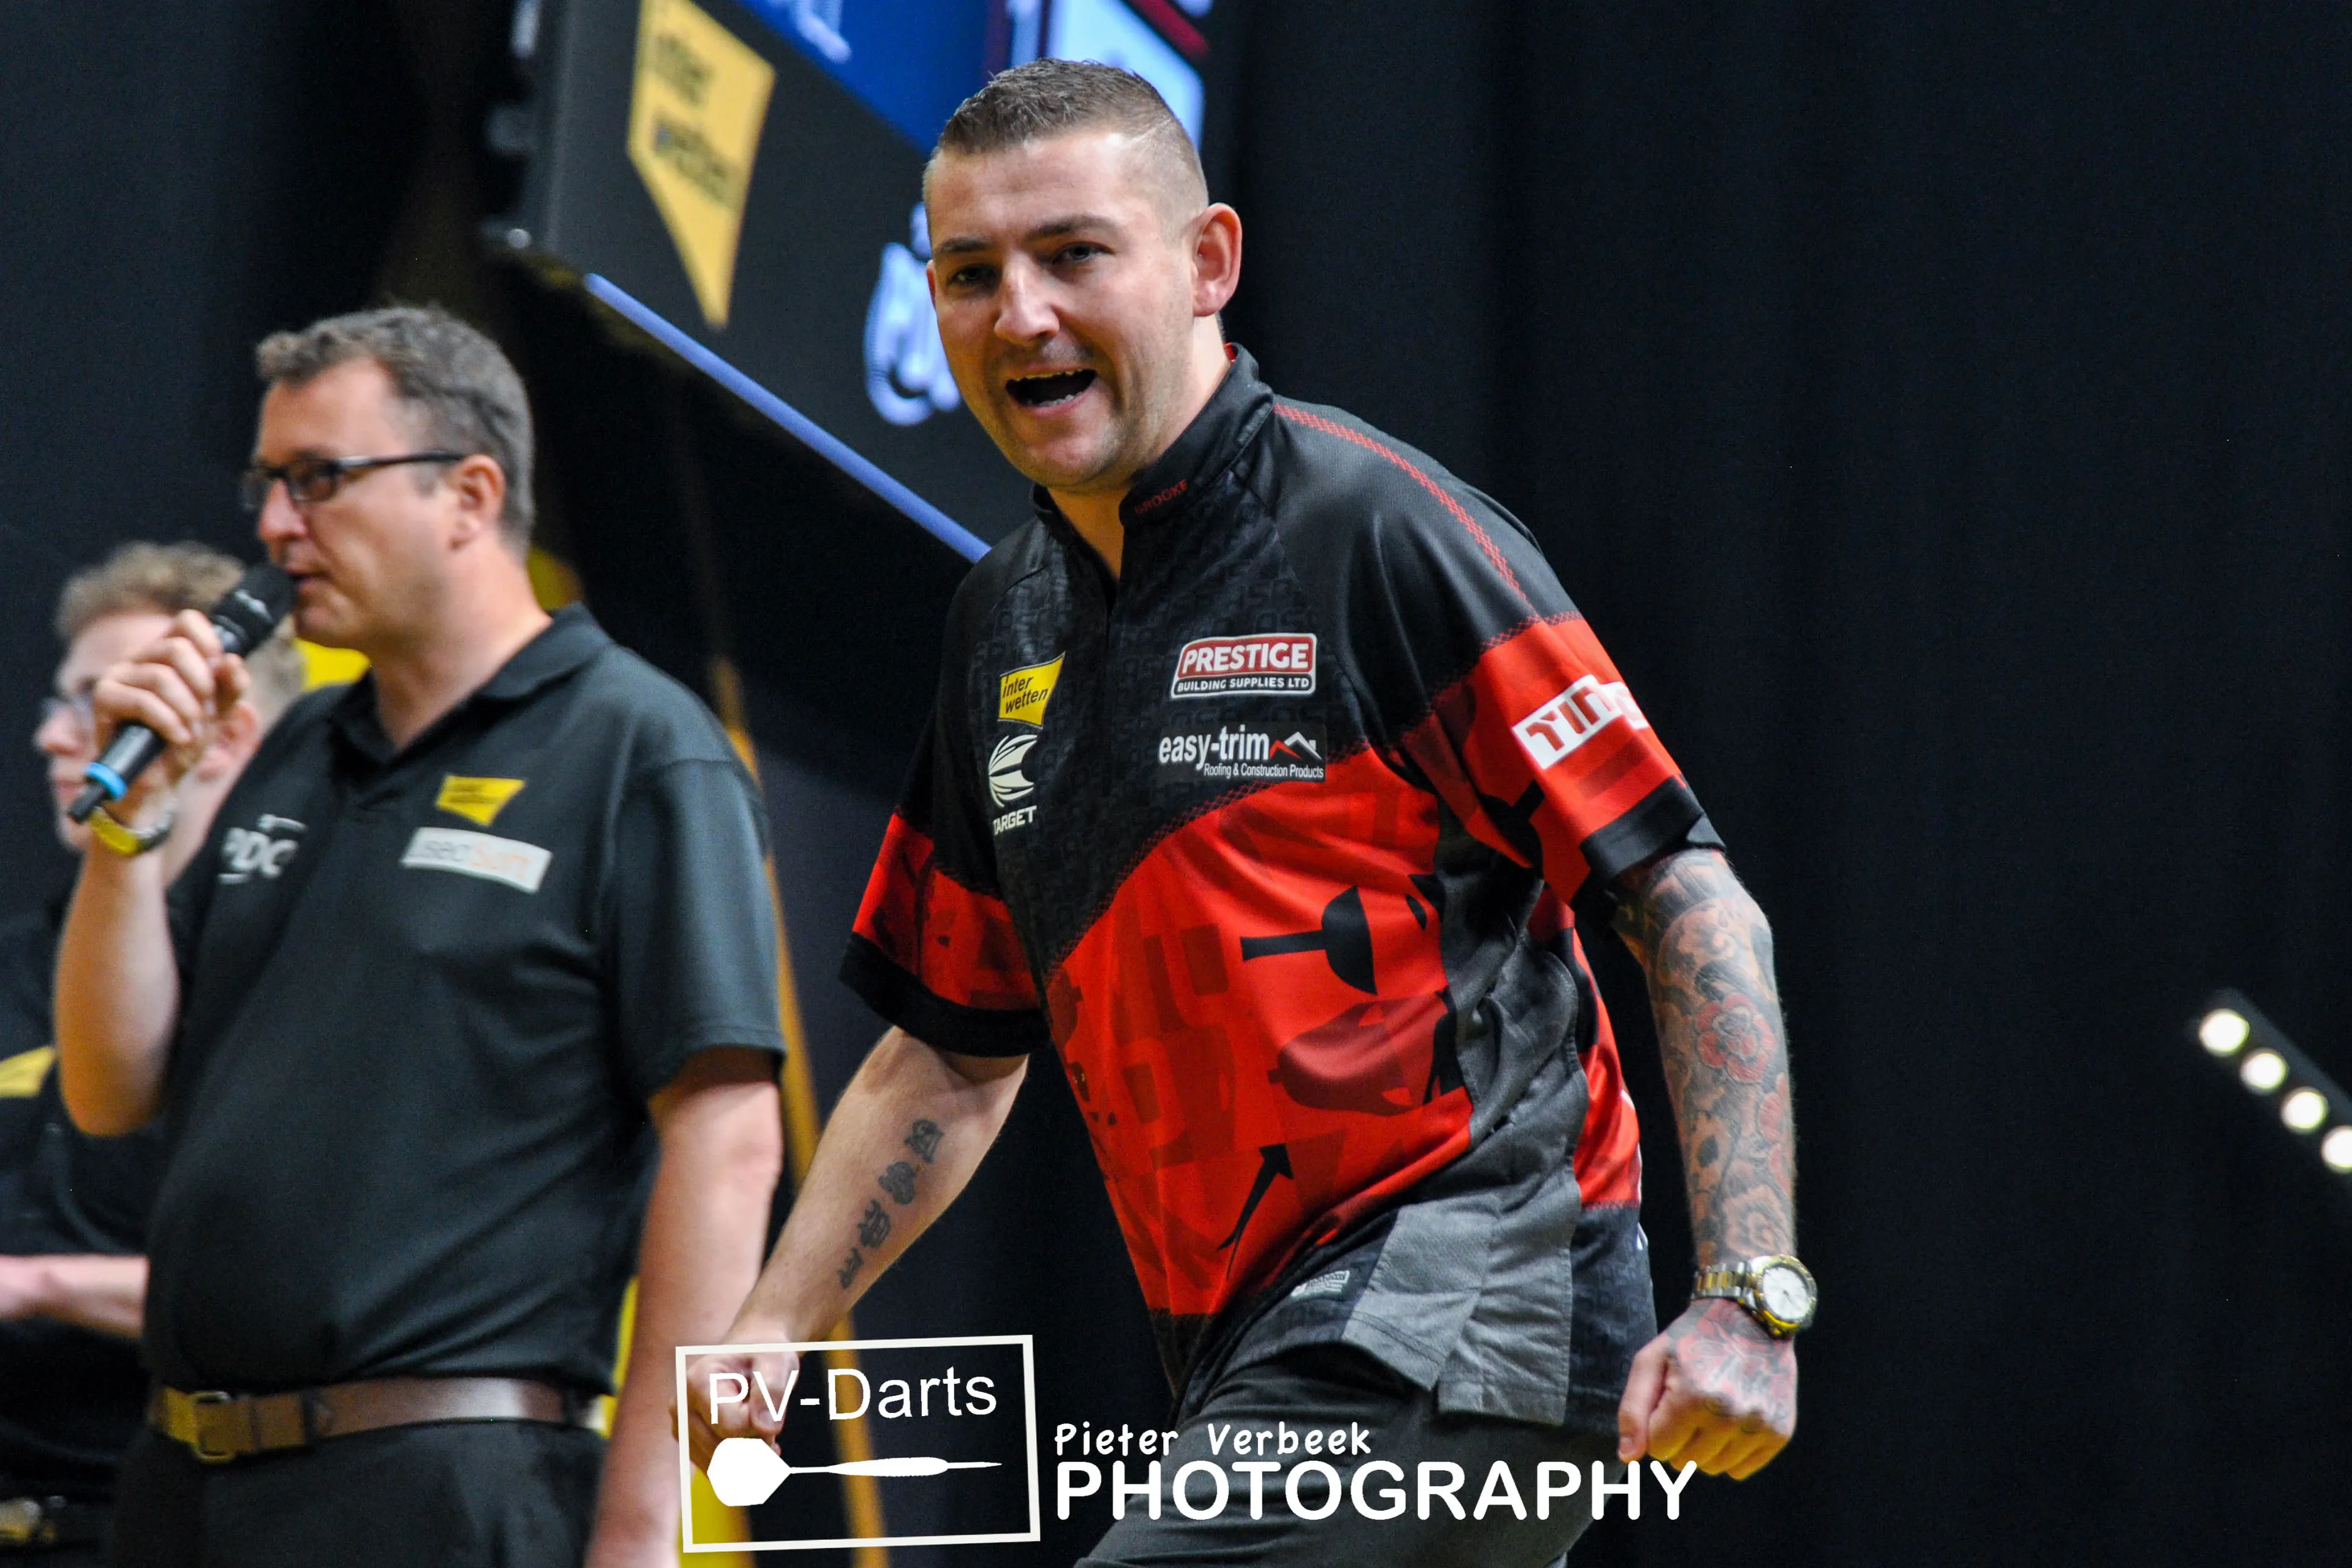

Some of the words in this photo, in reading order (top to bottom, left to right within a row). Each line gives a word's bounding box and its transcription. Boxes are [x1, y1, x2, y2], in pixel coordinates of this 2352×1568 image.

[1182, 643, 1309, 674] PRESTIGE
[1002, 675, 1034, 698] inter
[1177, 679, 1226, 692] BUILDING
[1229, 677, 1284, 688] SUPPLIES
[1287, 677, 1310, 688] LTD
[1005, 688, 1048, 714] wetten
[1158, 724, 1270, 771] easy-trim
[1204, 763, 1231, 779] Roofing
[1233, 764, 1239, 776] &
[1241, 763, 1287, 777] Construction
[1289, 764, 1324, 778] Products
[993, 805, 1037, 835] TARGET
